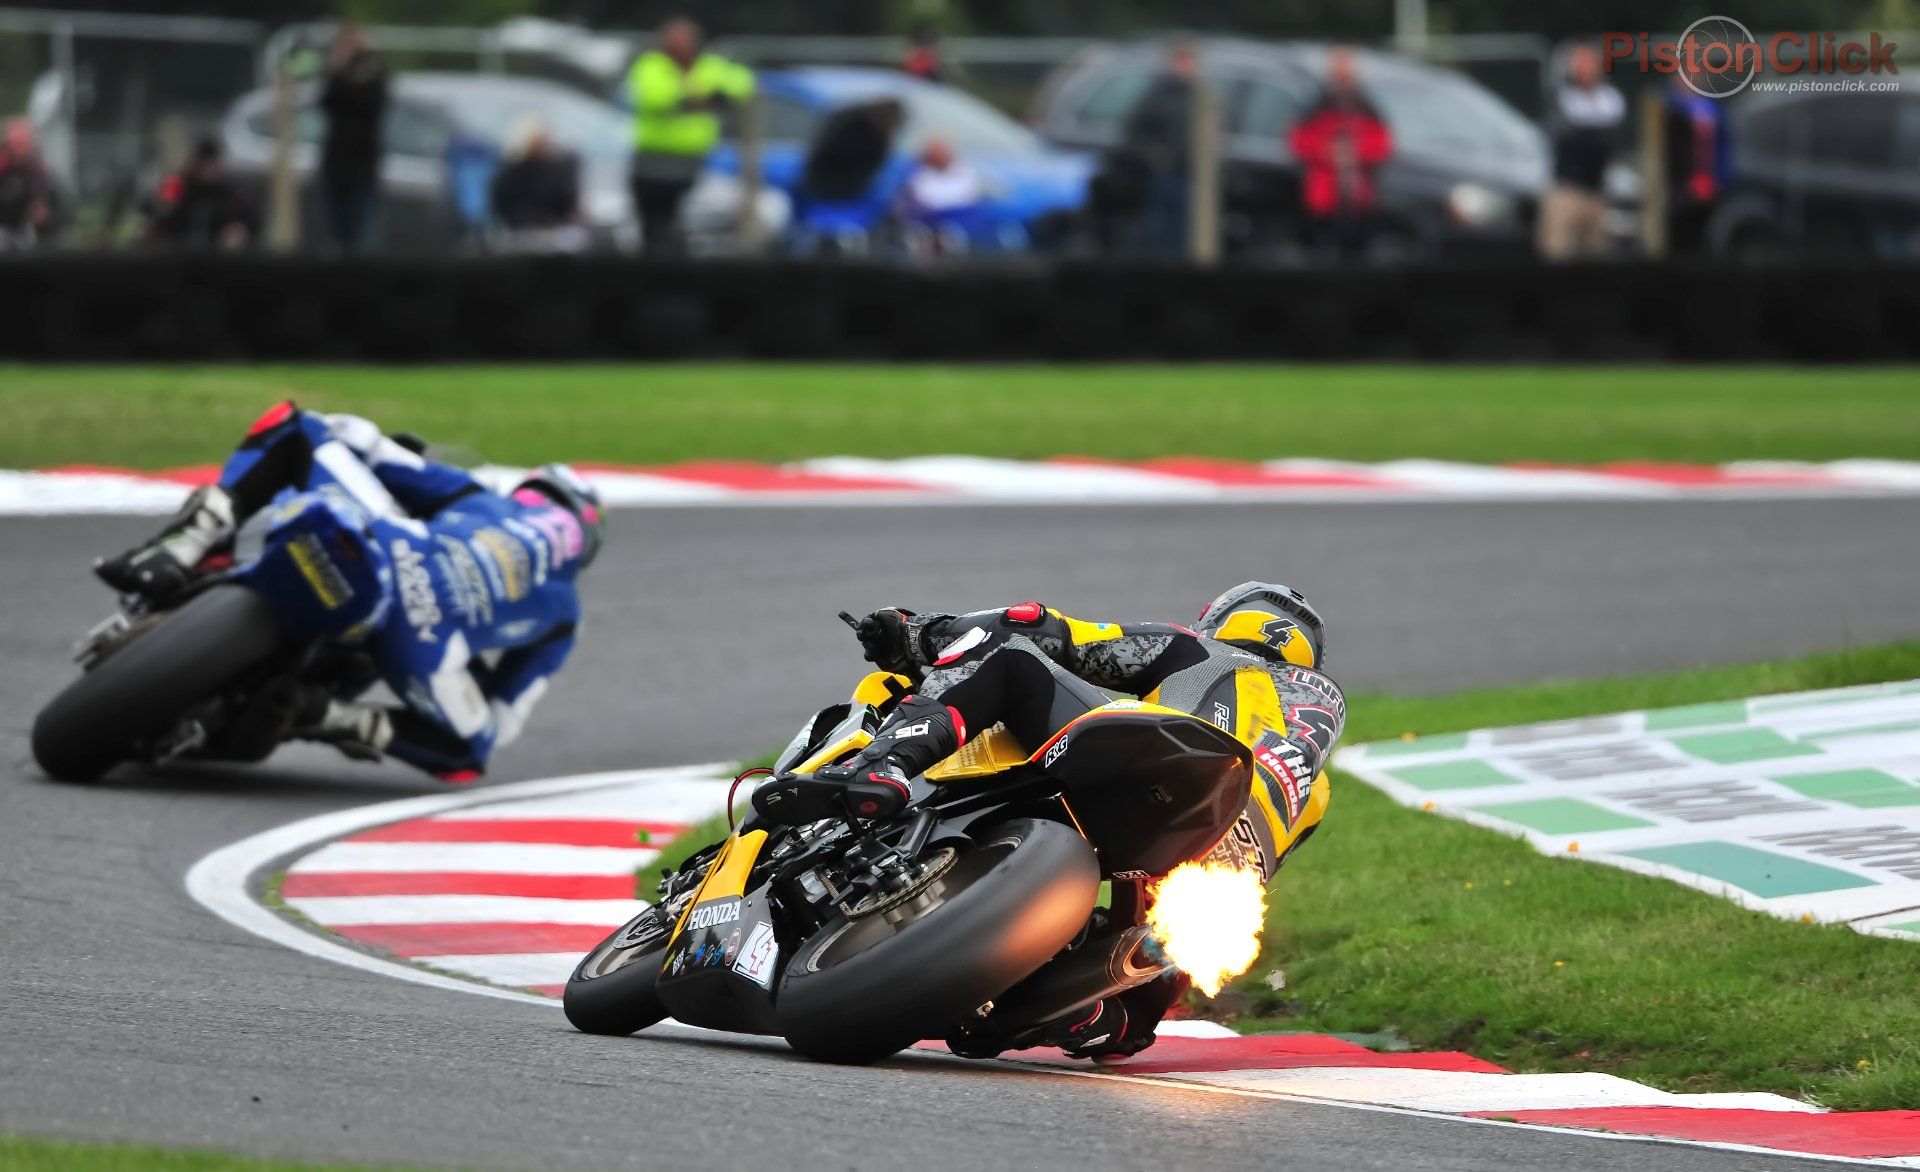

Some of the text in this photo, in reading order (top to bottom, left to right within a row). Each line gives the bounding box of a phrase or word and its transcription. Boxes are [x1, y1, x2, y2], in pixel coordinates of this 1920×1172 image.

[1261, 618, 1299, 650] 4
[1259, 752, 1298, 818] Honda
[687, 900, 741, 931] HONDA
